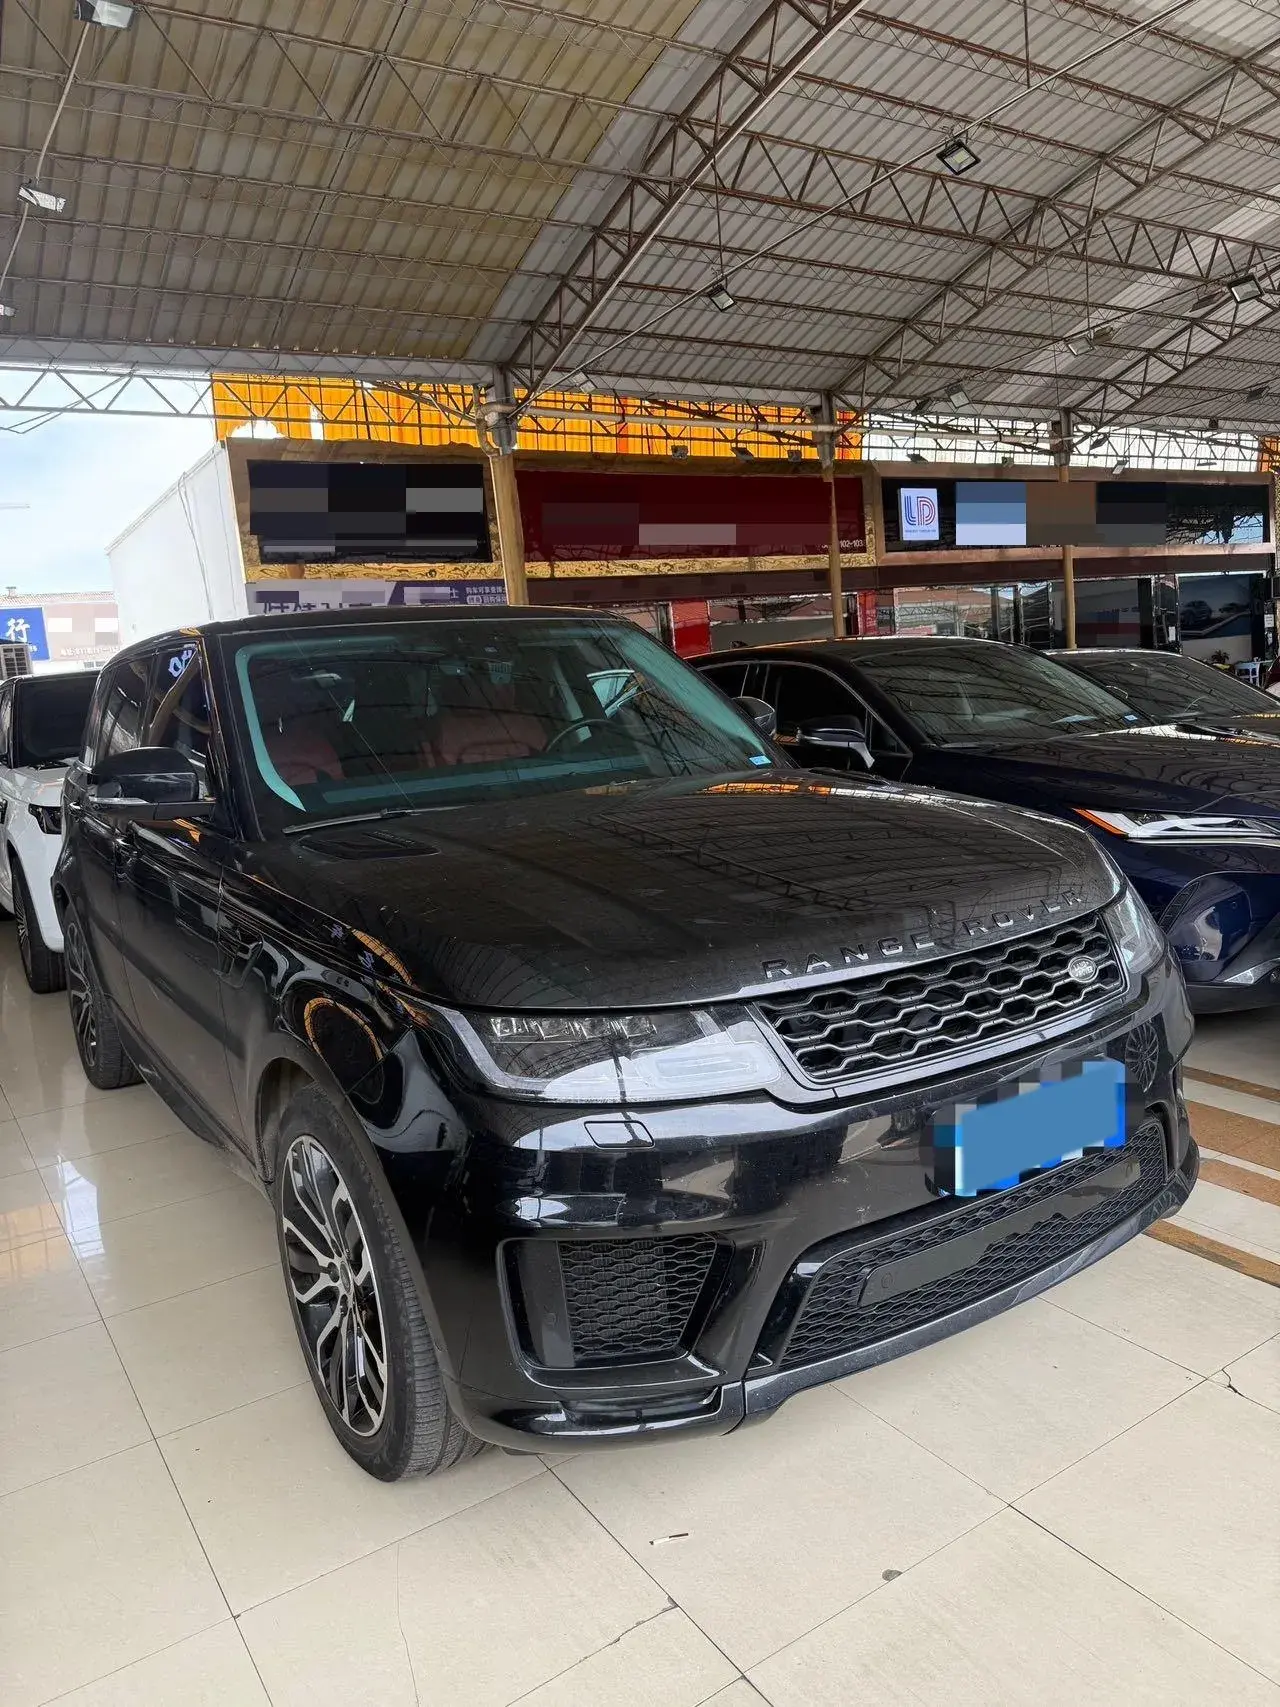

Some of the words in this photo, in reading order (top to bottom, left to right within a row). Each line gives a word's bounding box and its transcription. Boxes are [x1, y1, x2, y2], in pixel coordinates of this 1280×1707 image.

[5, 617, 31, 642] 行
[761, 930, 935, 979] RANGE
[961, 889, 1082, 936] ROVER
